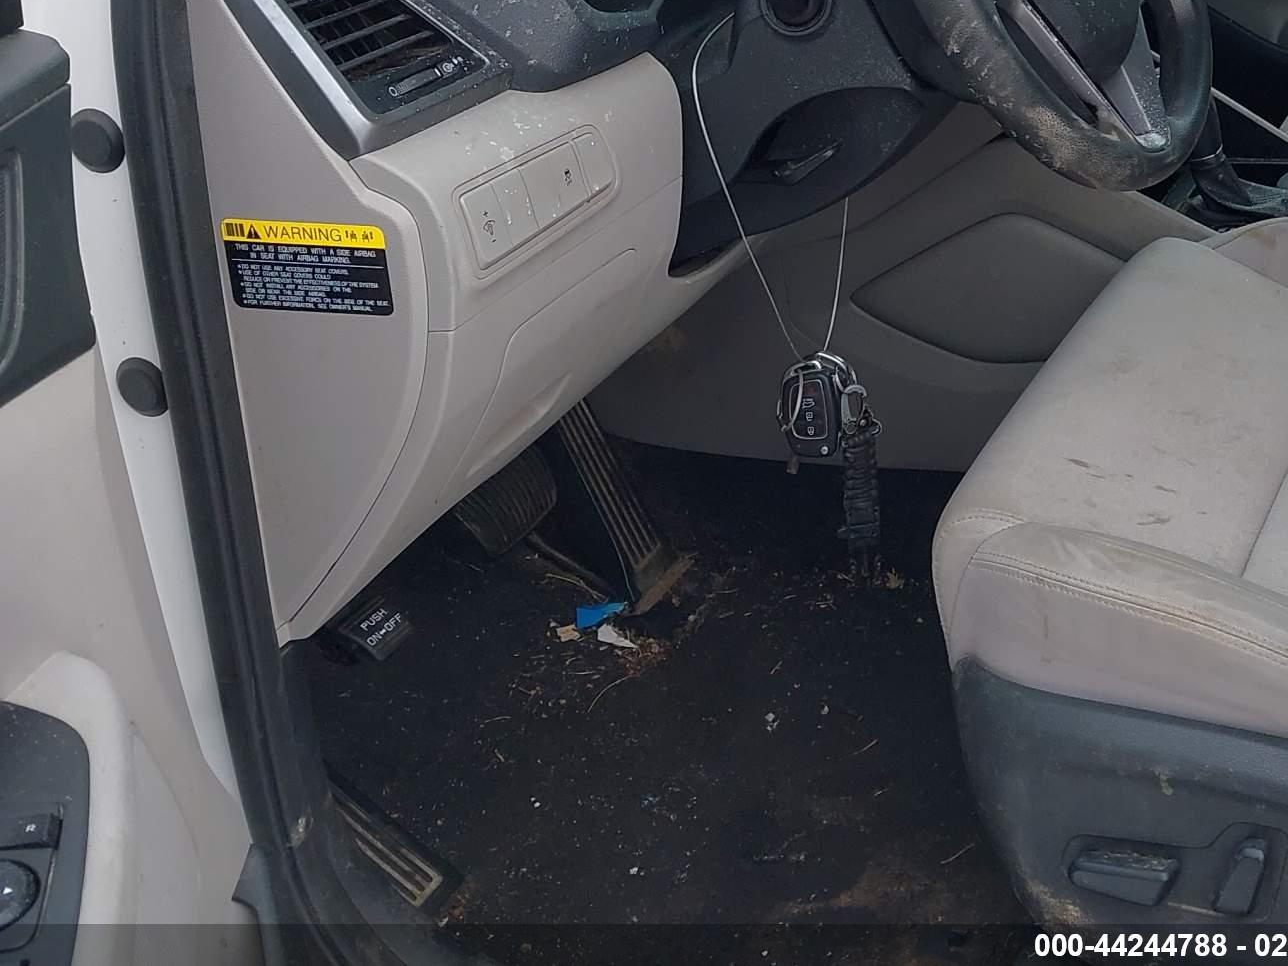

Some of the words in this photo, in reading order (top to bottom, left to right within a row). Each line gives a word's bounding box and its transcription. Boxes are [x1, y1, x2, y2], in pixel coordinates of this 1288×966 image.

[263, 225, 342, 242] WARNING
[235, 243, 249, 251] THIS
[251, 244, 265, 252] CAR
[278, 246, 308, 254] EQUIPPED
[310, 247, 326, 255] WITH
[336, 249, 351, 257] SIDE
[353, 250, 376, 258] AIRBAG
[260, 252, 275, 260] SEAT
[278, 253, 294, 261] WITH
[297, 254, 319, 262] AIRBAG
[360, 608, 388, 631] PUSH
